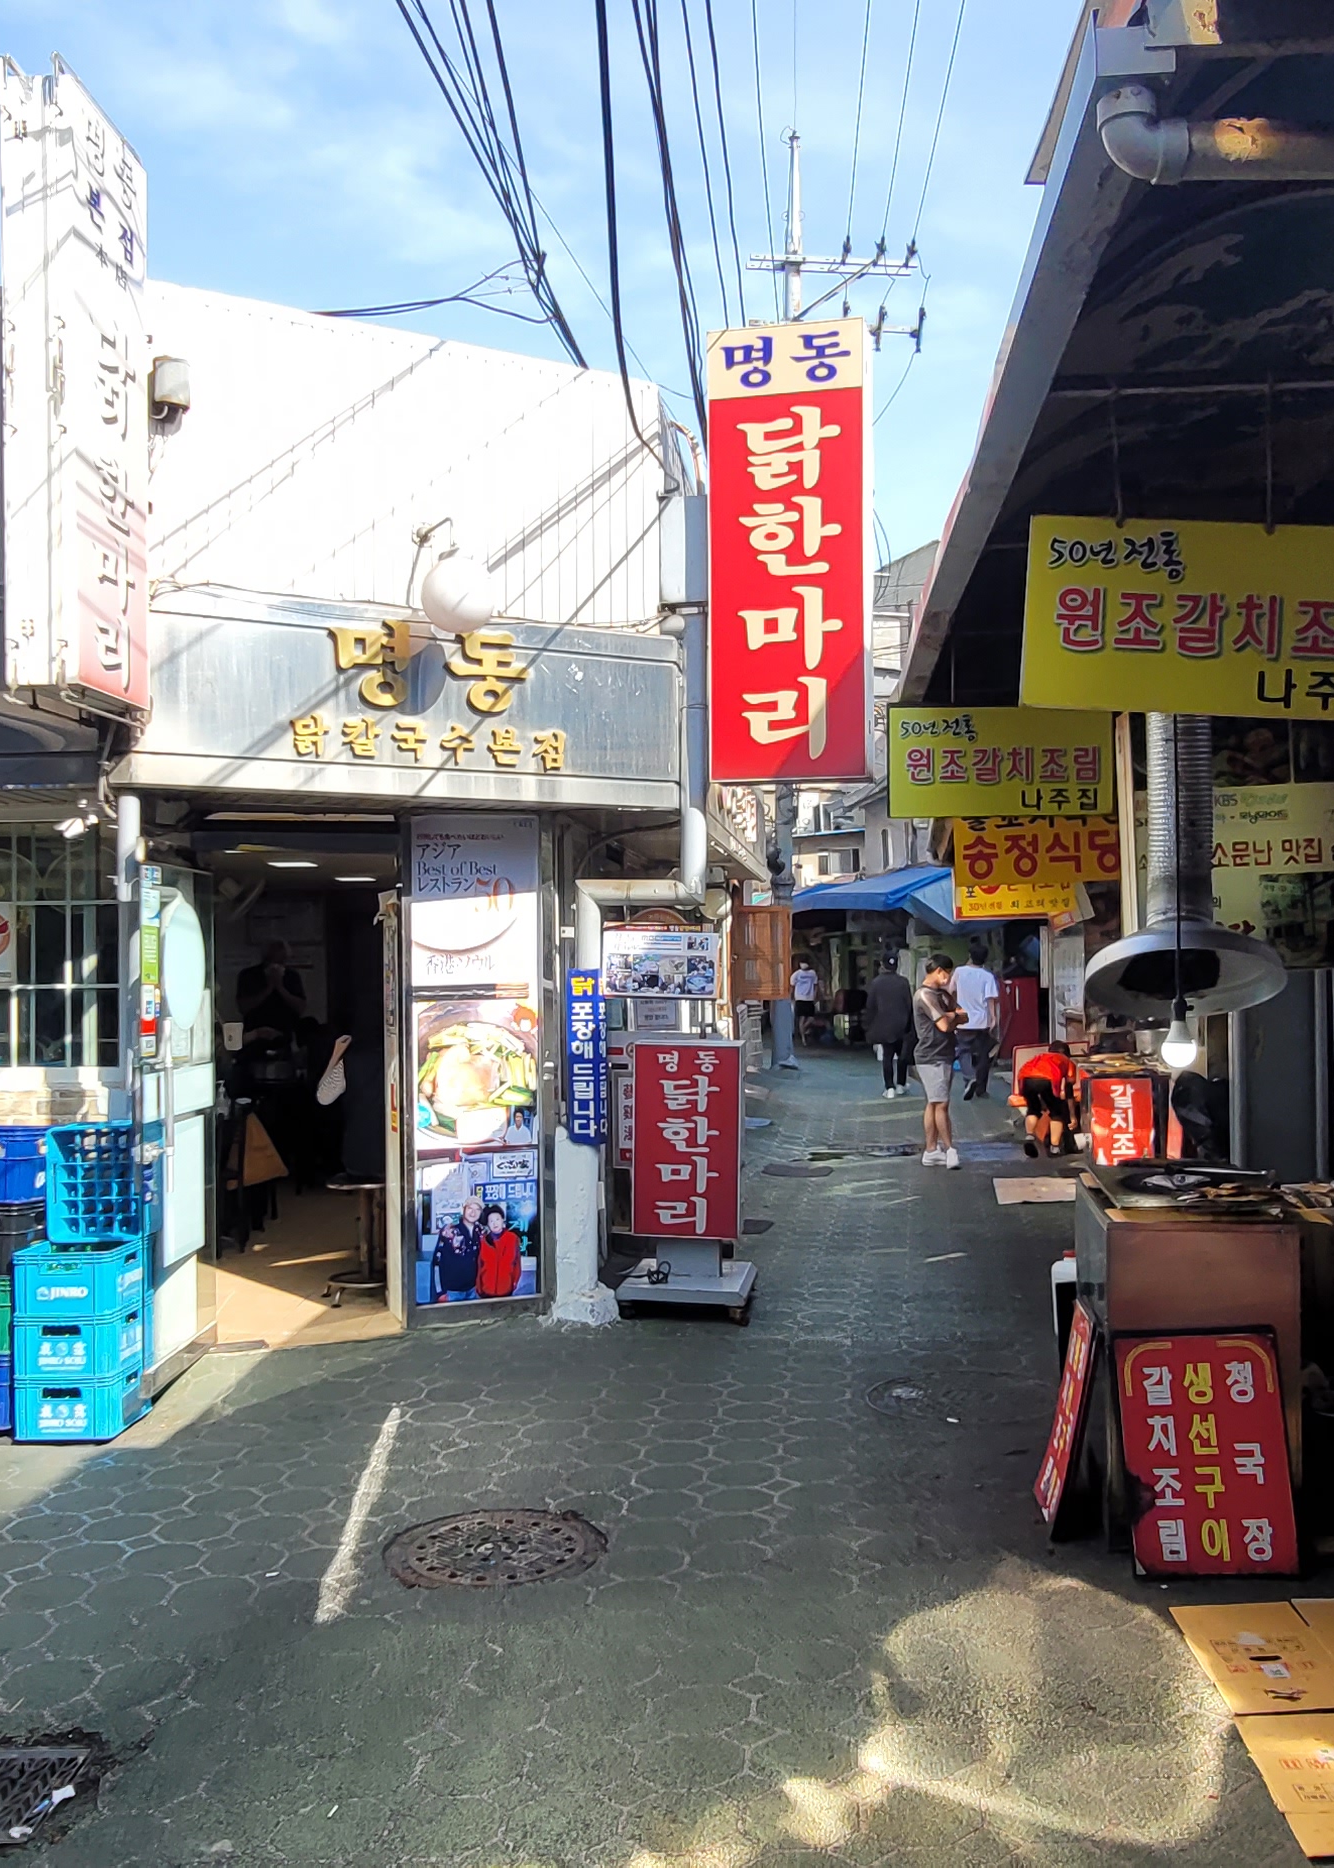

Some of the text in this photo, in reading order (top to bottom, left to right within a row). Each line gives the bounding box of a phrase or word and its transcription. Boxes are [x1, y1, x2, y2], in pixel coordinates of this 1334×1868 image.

[720, 329, 851, 389] 명동
[736, 405, 843, 761] 닭한마리
[1048, 532, 1186, 583] 50년 전통
[328, 619, 531, 714] 명동
[905, 746, 1100, 784] 원조갈치조림
[1021, 787, 1098, 811] 나주집
[416, 843, 461, 859] アジア
[417, 861, 498, 876] Best of Best
[1281, 837, 1323, 866] 맛집
[417, 876, 475, 894] レストラン
[657, 1051, 719, 1073] 명동
[1110, 1083, 1136, 1166] 갈치조
[654, 1074, 720, 1235] 닭한마리
[1142, 1366, 1188, 1562] 갈치조림
[1182, 1362, 1231, 1562] 생선구이
[1225, 1361, 1273, 1562] 청국장
